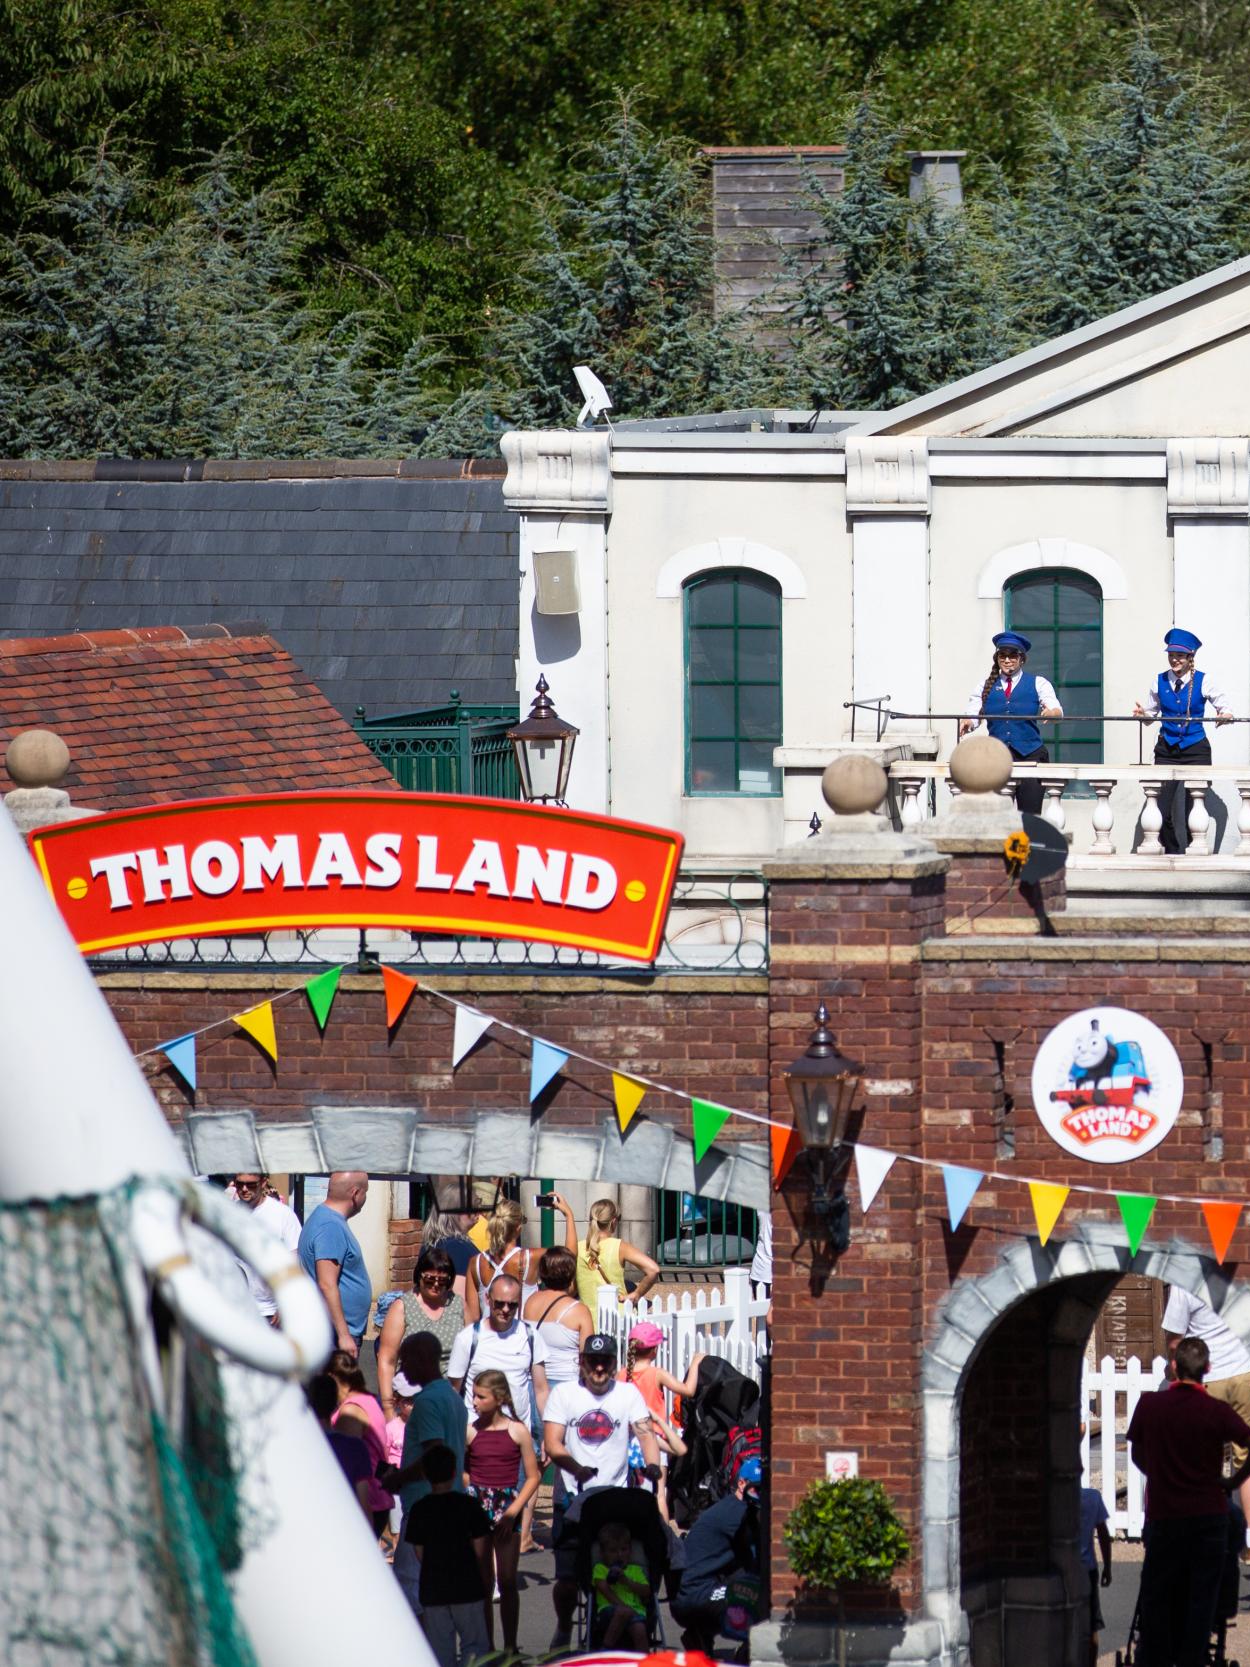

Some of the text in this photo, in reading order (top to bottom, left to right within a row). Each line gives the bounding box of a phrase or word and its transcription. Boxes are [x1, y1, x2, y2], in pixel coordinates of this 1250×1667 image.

[89, 833, 618, 911] THOMAS LAND
[1067, 1106, 1152, 1132] THOMAS
[1087, 1119, 1133, 1138] LAND
